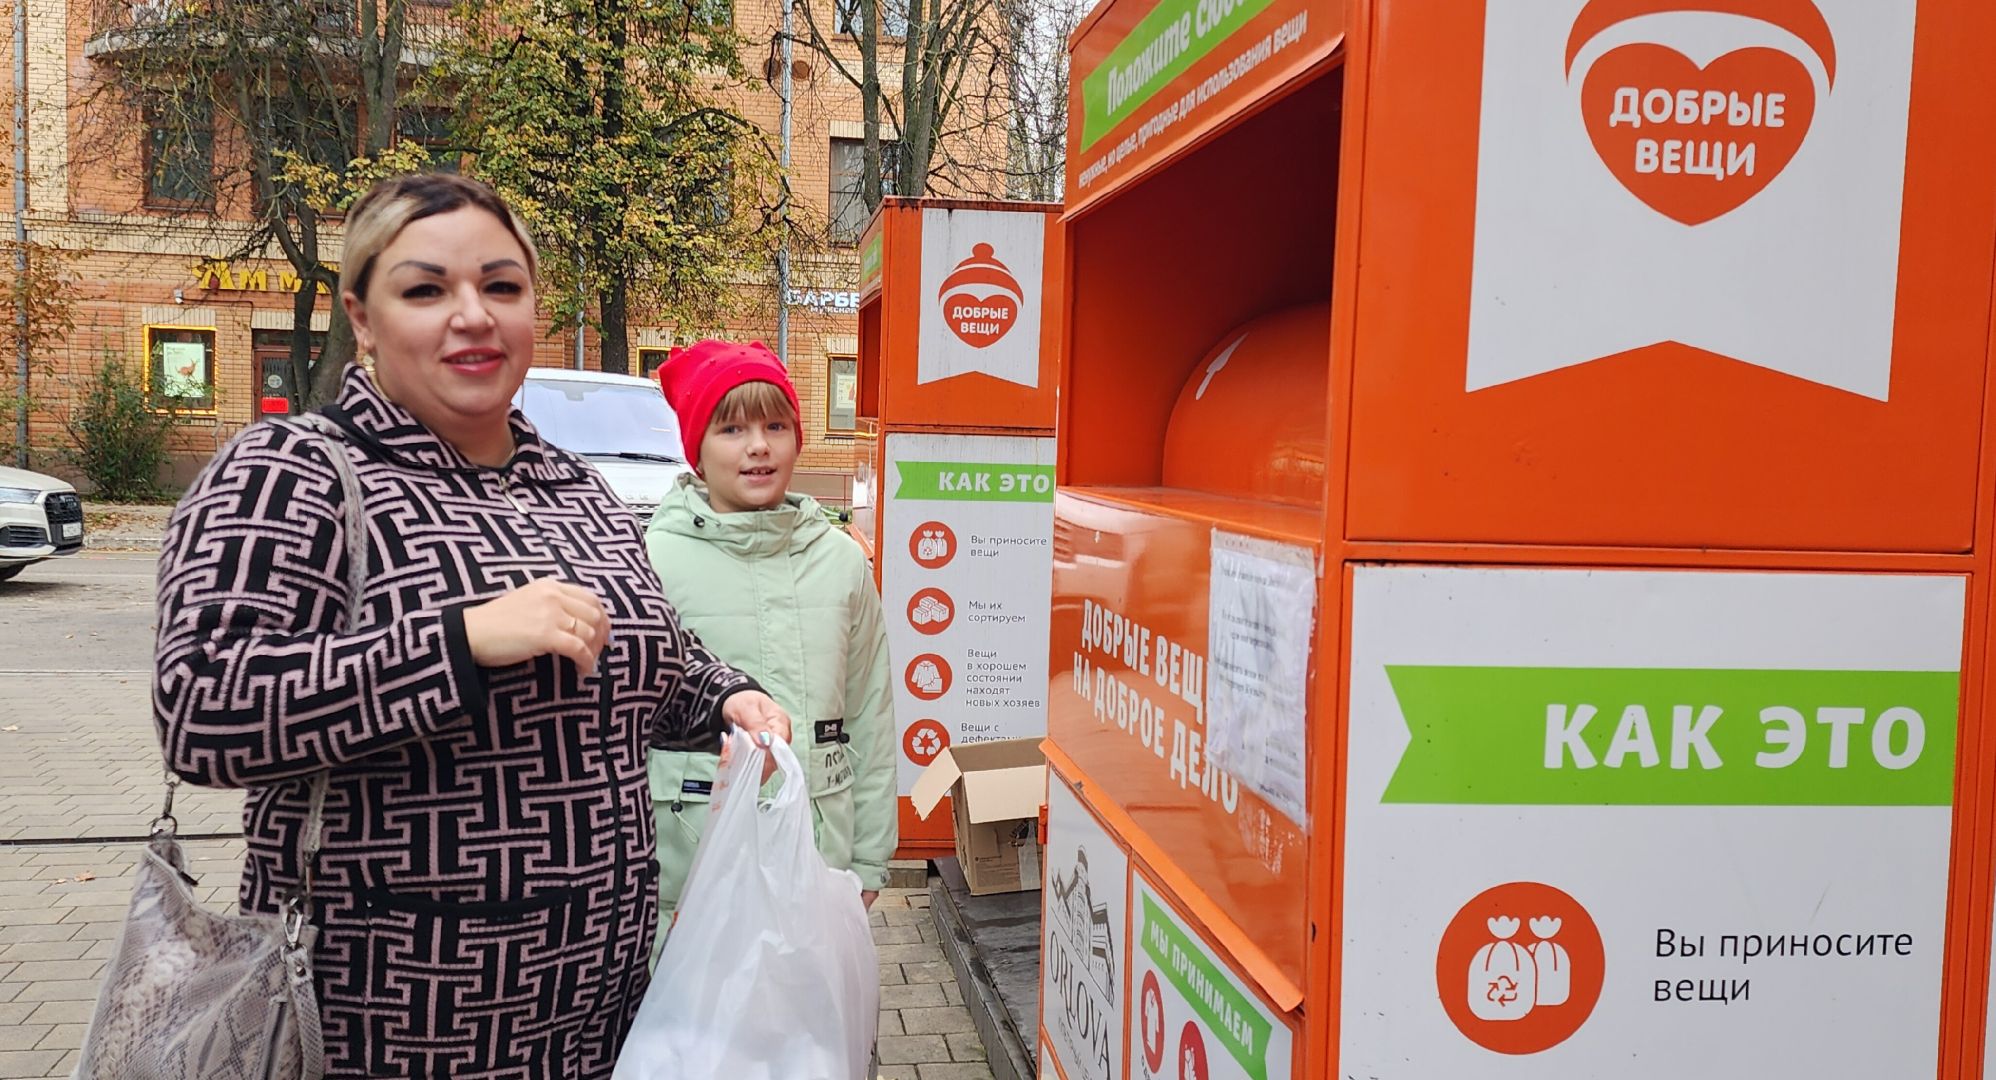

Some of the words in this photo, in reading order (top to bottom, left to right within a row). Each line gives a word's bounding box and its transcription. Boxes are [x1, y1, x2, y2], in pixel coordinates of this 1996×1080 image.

[1107, 11, 1191, 116] Положите
[1195, 0, 1245, 38] сю
[1138, 101, 1179, 148] пригодные
[1179, 89, 1196, 121] для
[1197, 34, 1272, 106] использования
[1273, 9, 1308, 53] вещи
[1609, 87, 1786, 128] ДОБРЫЕ
[1635, 139, 1756, 180] ВЕЩИ
[952, 305, 1009, 320] ДОБРЫЕ
[960, 321, 1000, 335] ВЕЩИ
[938, 471, 991, 492] КАК
[999, 473, 1050, 494] ЭТО
[971, 535, 986, 546] Вы
[989, 535, 1047, 548] приносите
[970, 548, 999, 559] вещи
[968, 600, 986, 611] Мы
[990, 602, 1003, 611] их
[968, 614, 1026, 625] сортируем
[967, 649, 997, 661] Вещи
[1081, 599, 1150, 676] ДОБРЫЕ
[1155, 635, 1203, 725] ВЕЩ
[967, 662, 973, 671] в
[976, 662, 1027, 674] хорошем
[966, 674, 1023, 684] состоянии
[966, 687, 1011, 697] находят
[966, 699, 1000, 708] новых
[1003, 699, 1041, 708] хозяев
[961, 723, 991, 734] Вещи
[994, 725, 999, 733] с
[1073, 651, 1091, 701] НА
[1094, 666, 1165, 759] ДОБРОЕ
[1170, 719, 1239, 814] ДЕЛО
[961, 734, 1022, 744] дефект
[1543, 703, 1724, 770] КАК
[1754, 705, 1926, 770] ЭТО
[1654, 928, 1705, 958] Вы
[1720, 930, 1913, 964] приносите
[1151, 919, 1168, 957] МЫ
[1171, 948, 1253, 1056] ПРИНИМАЕМ
[1653, 977, 1750, 1005] вещи
[1050, 931, 1111, 1080] ORLOVA
